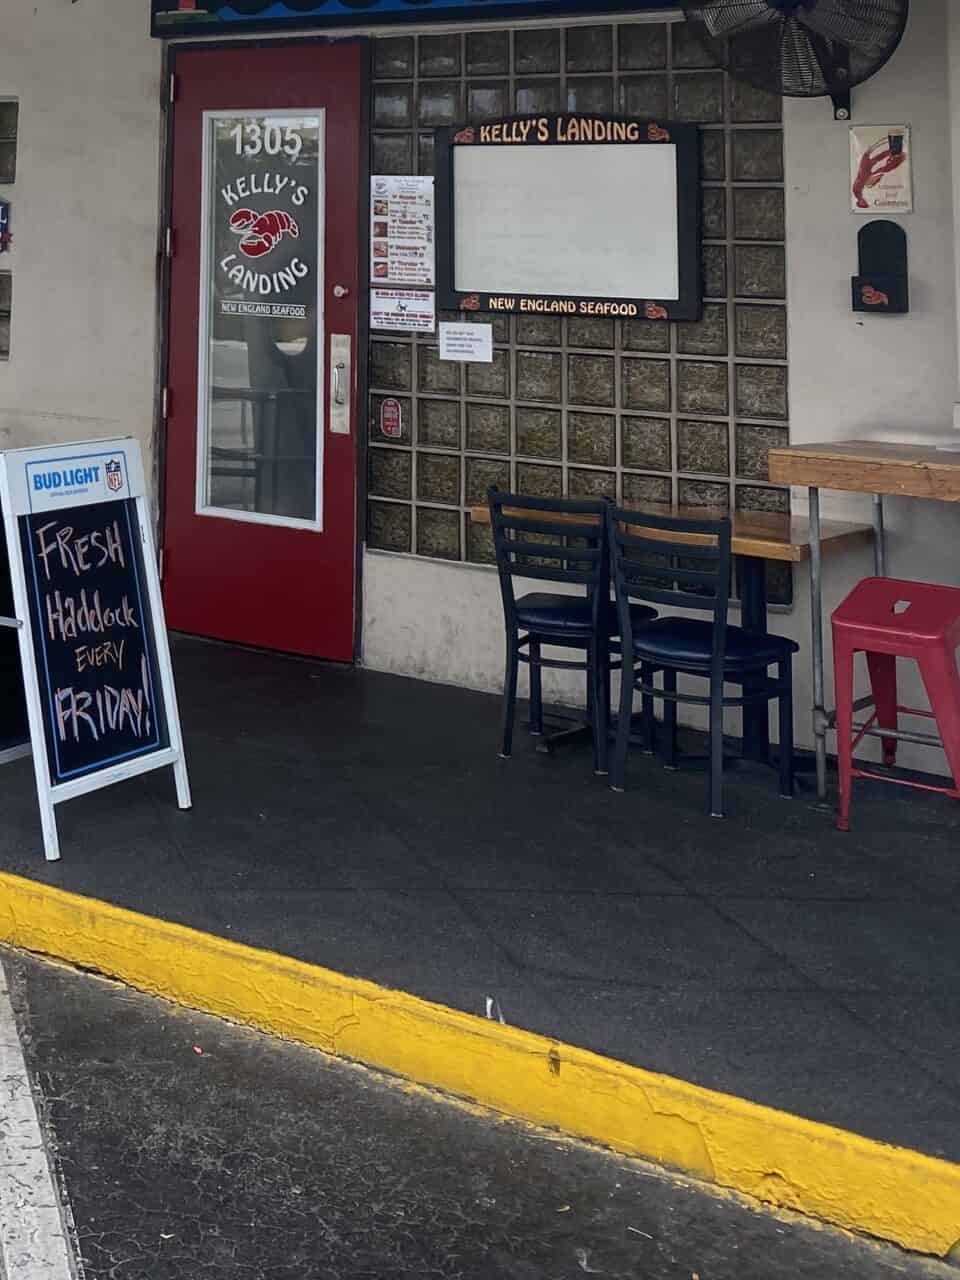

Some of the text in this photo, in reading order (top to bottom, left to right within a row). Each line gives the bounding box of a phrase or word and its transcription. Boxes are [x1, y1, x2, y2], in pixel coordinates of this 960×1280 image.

[230, 124, 302, 155] 1305
[480, 118, 639, 142] KELLY'S LANDING
[221, 173, 308, 205] KELLY'S
[221, 254, 308, 295] LANDING
[238, 304, 270, 314] ENGLAND
[272, 306, 305, 316] SEAFOOD
[489, 297, 637, 316] NEW ENGLAND SEAFOOD
[33, 466, 99, 490] BUD LIGHT
[36, 520, 125, 580] FRESH
[46, 588, 139, 641] Haddock
[75, 639, 125, 673] EVERY
